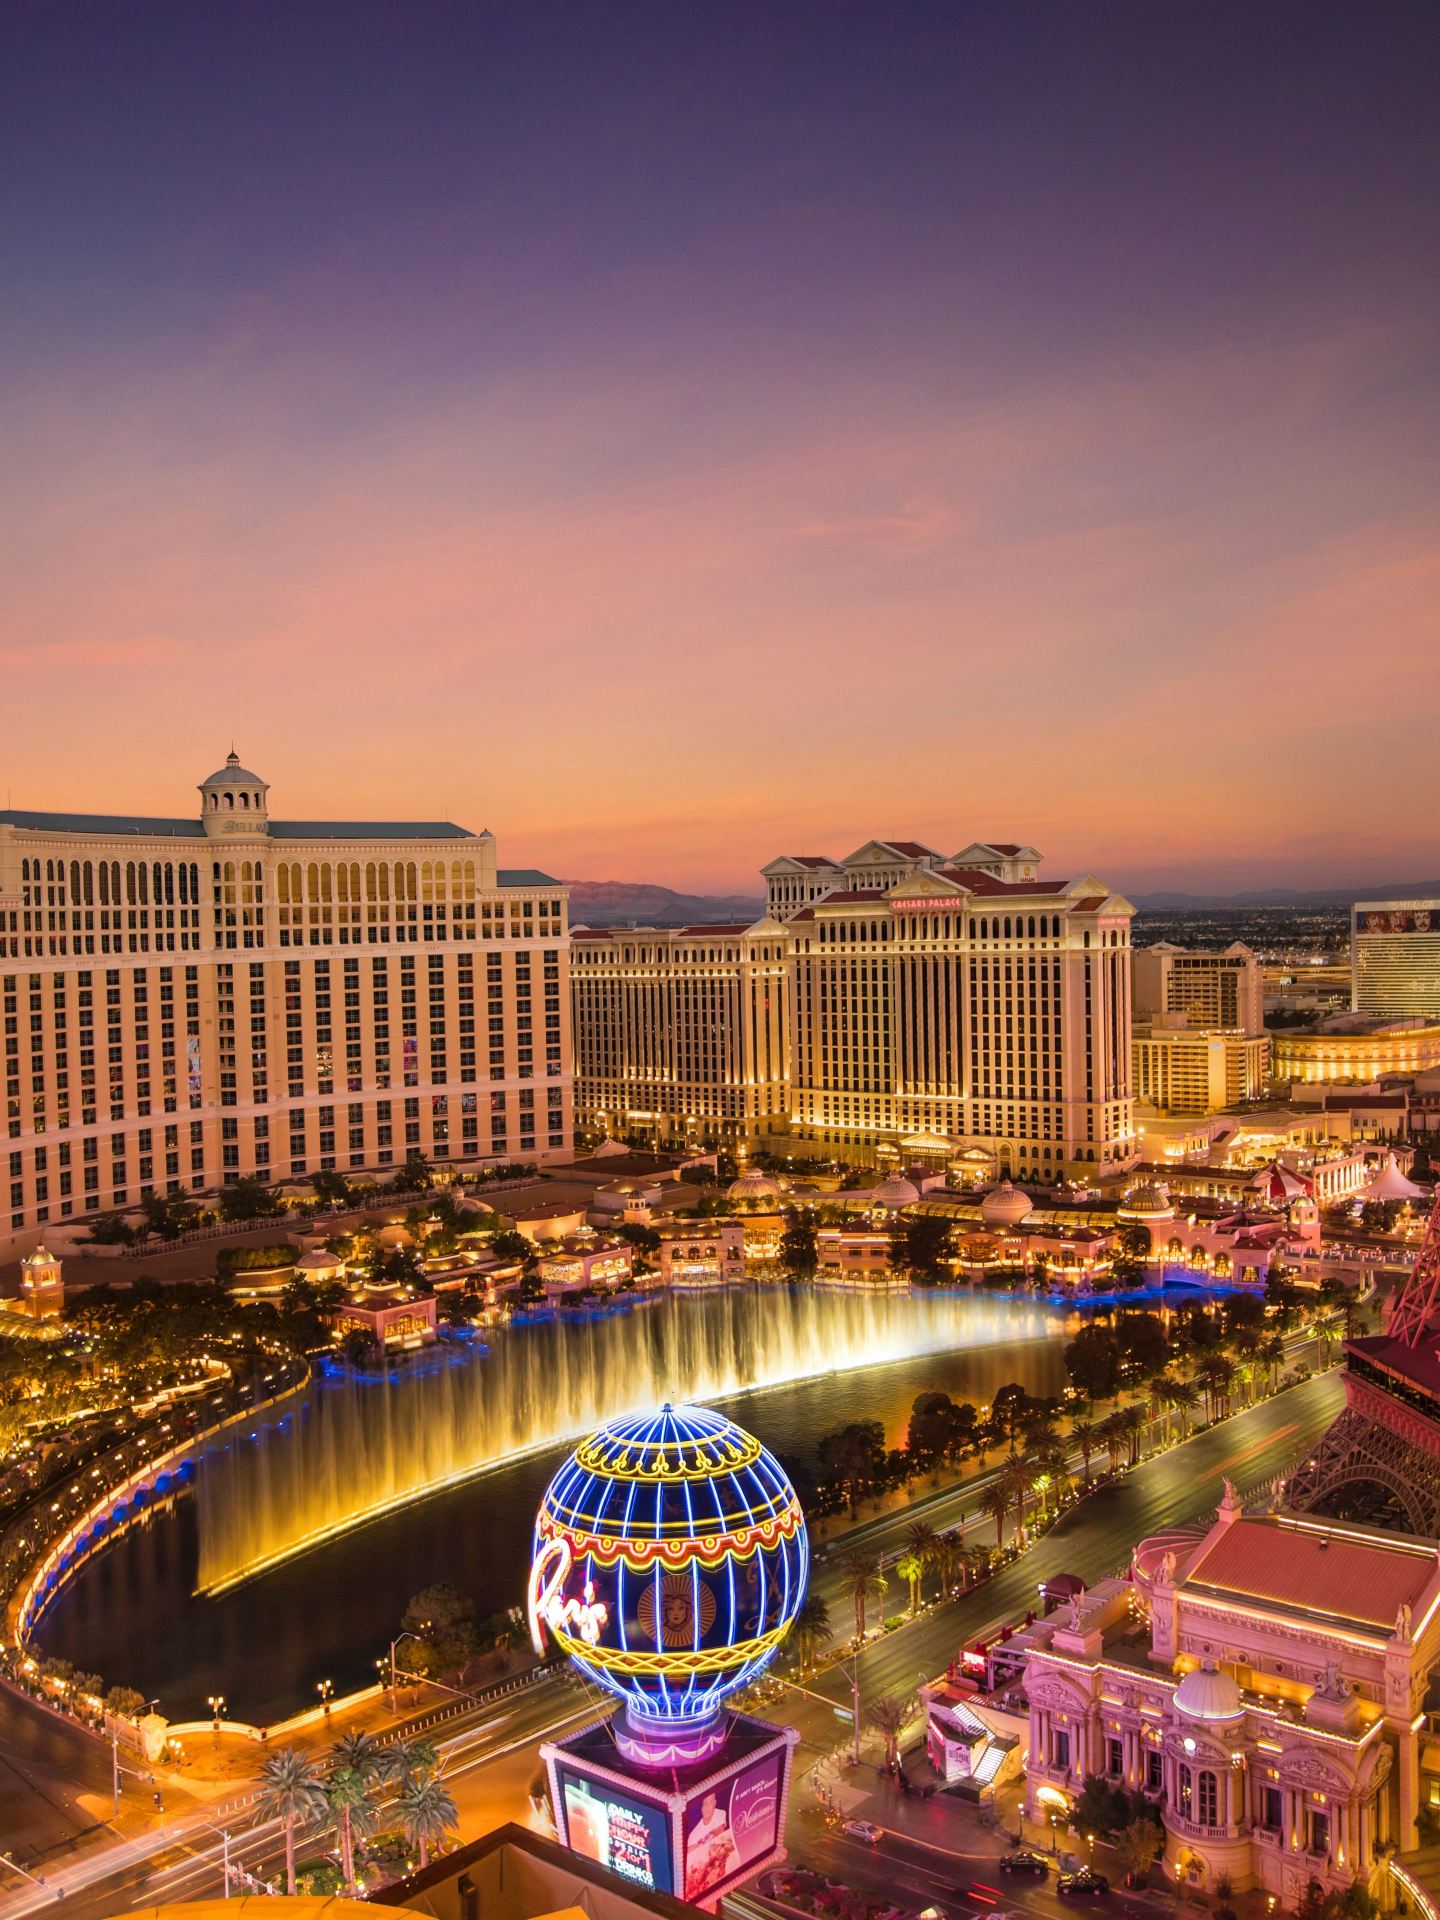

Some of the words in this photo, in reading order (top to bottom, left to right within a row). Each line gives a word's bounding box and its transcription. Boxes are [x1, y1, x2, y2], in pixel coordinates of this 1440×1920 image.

[892, 900, 926, 909] CAESARS
[928, 898, 960, 907] PALACE
[608, 1802, 643, 1825] DAILY
[609, 1824, 646, 1848] HOUR
[611, 1816, 649, 1838] HAPPY
[614, 1856, 654, 1884] DRINKS
